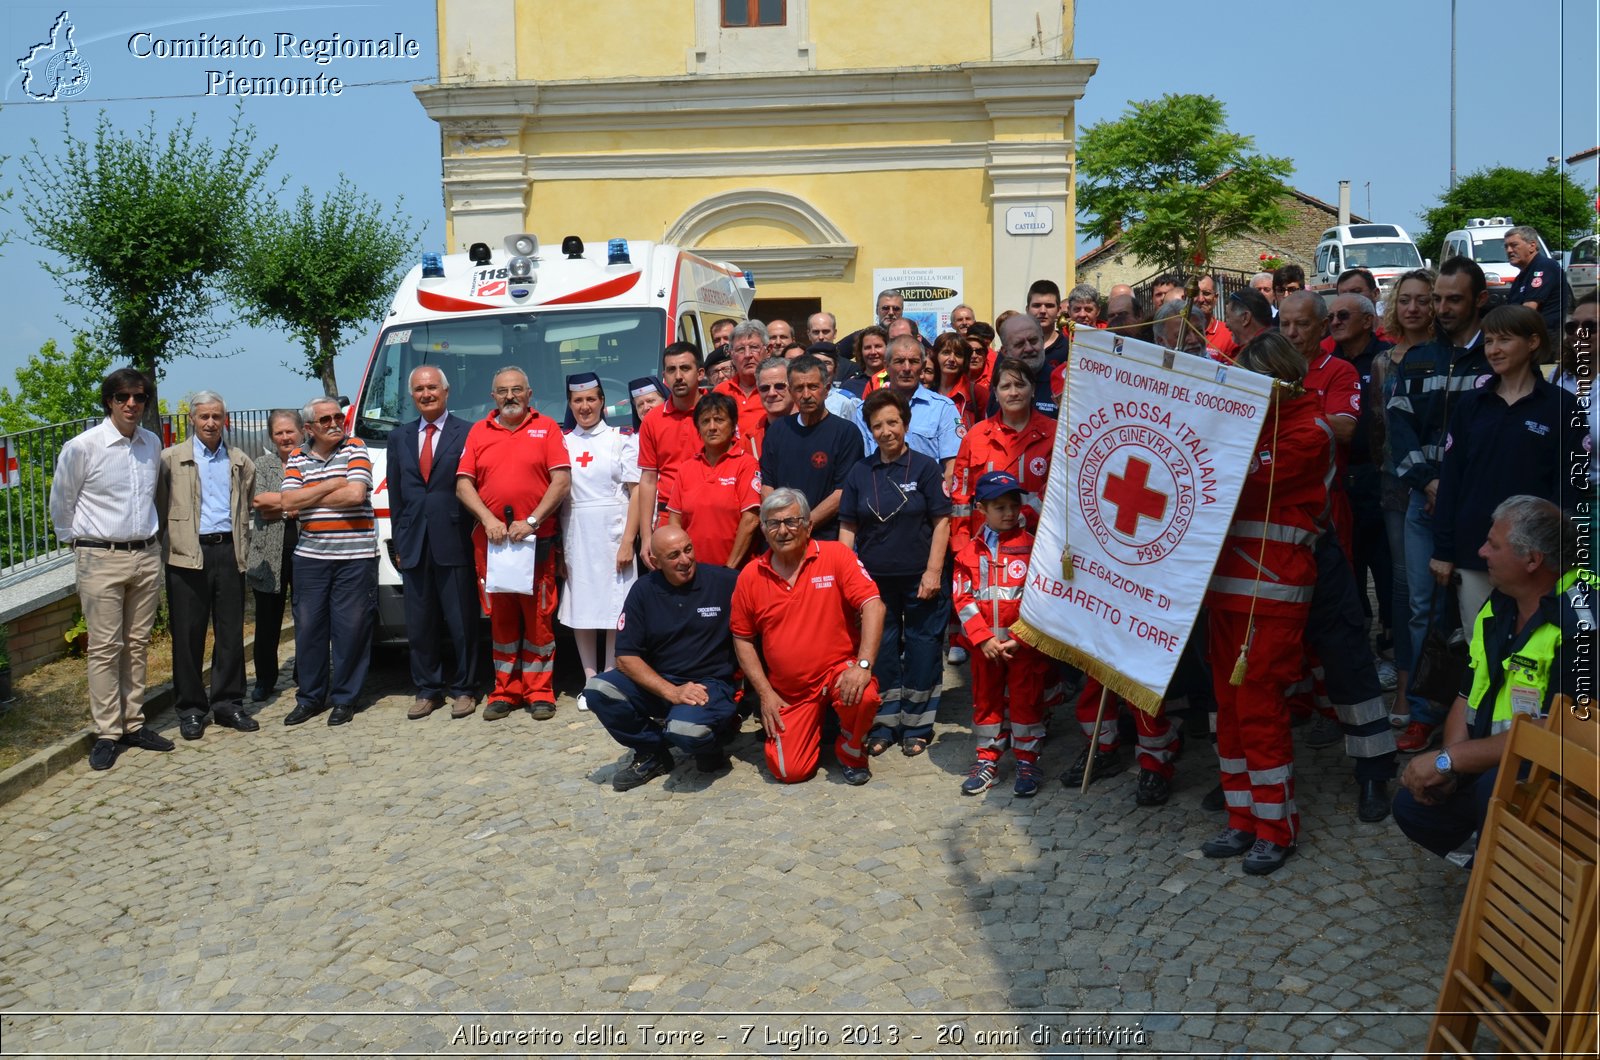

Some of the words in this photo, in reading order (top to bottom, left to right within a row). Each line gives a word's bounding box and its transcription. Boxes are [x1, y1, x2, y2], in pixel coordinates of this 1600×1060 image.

[478, 268, 508, 280] 118
[1080, 358, 1112, 378] CORPO
[1115, 368, 1169, 396] VOLONTARI
[1172, 386, 1190, 402] DEL
[1194, 392, 1256, 419] SOCCORSO
[1064, 408, 1109, 458] CROCE
[1113, 401, 1172, 429] ROSSA
[1175, 422, 1217, 505] ITALIANA
[1103, 434, 1116, 450] DI
[1119, 428, 1172, 459] GINEVRA
[1171, 459, 1189, 478] 22
[1082, 446, 1108, 545] CONVENZIONE
[1167, 485, 1192, 544] AGOSTO
[1060, 550, 1154, 603] ELEGAZIONE
[1158, 594, 1171, 611] DI
[1137, 542, 1167, 561] 1864
[1032, 574, 1122, 625] ALBARETTO
[1129, 616, 1179, 652] TORRE
